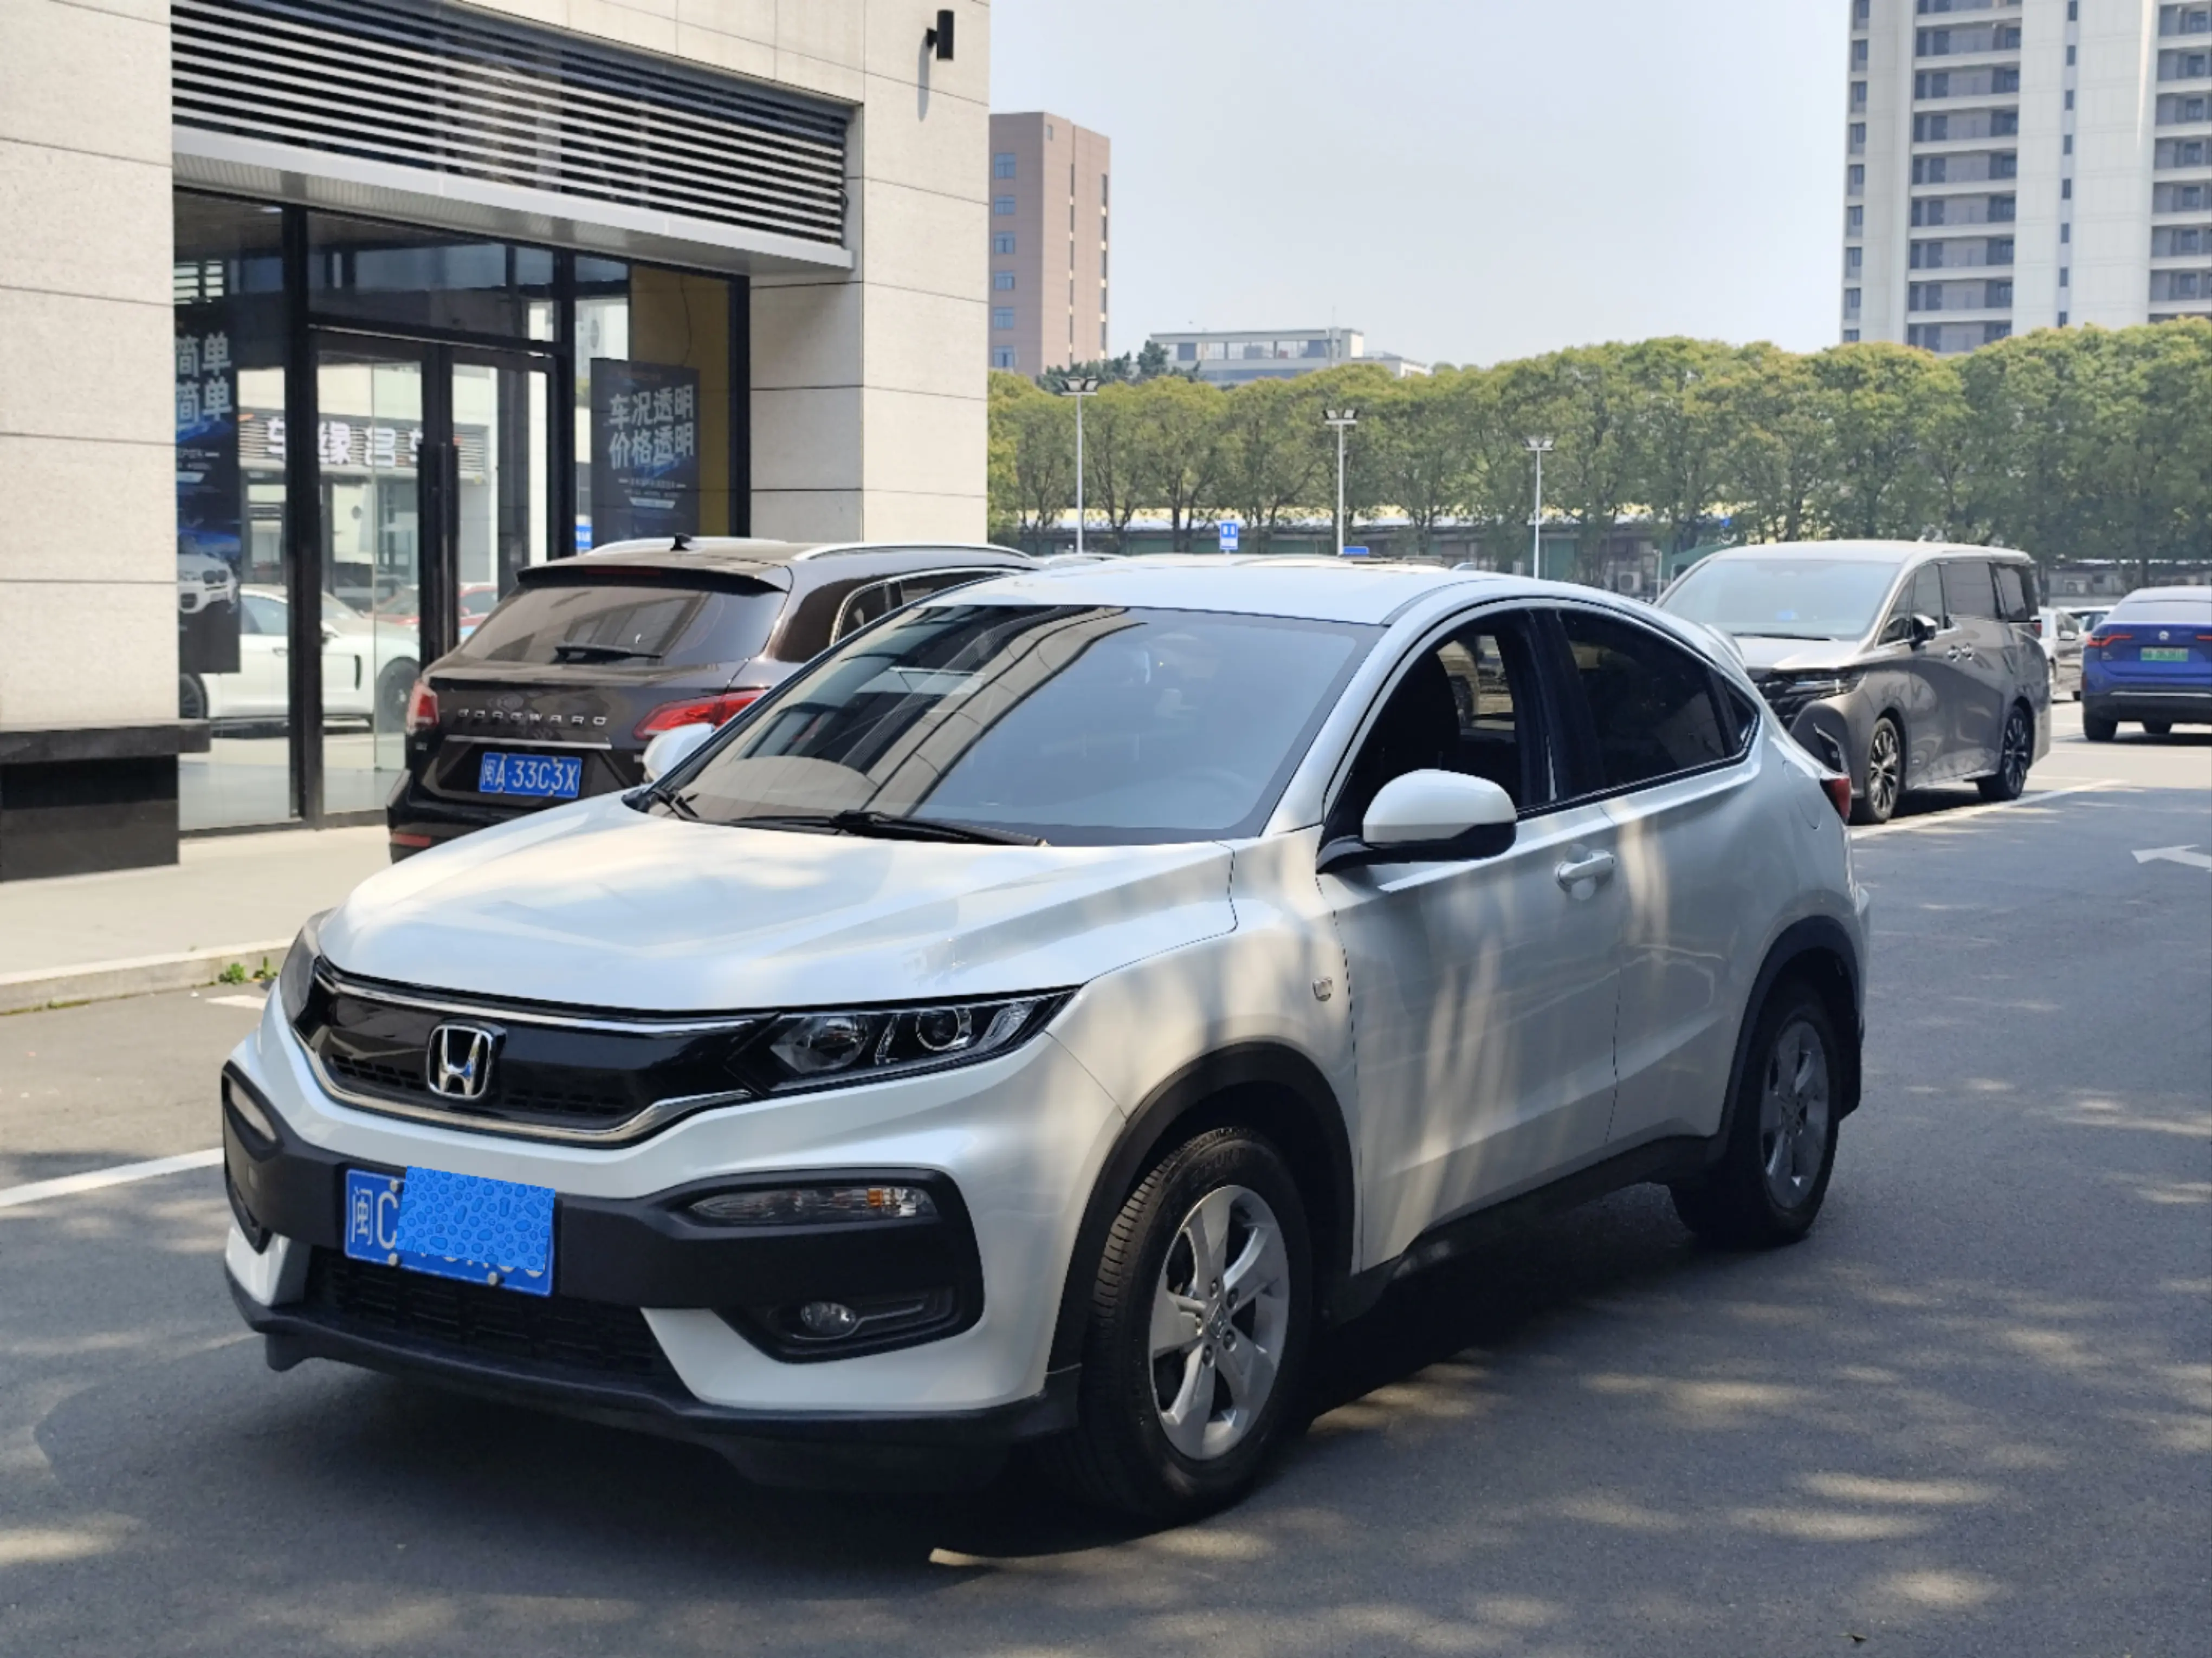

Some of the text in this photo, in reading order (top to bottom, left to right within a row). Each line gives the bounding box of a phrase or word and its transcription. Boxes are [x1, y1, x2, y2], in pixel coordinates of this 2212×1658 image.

[609, 384, 694, 430] 车况透明
[609, 422, 694, 470] 价格透明
